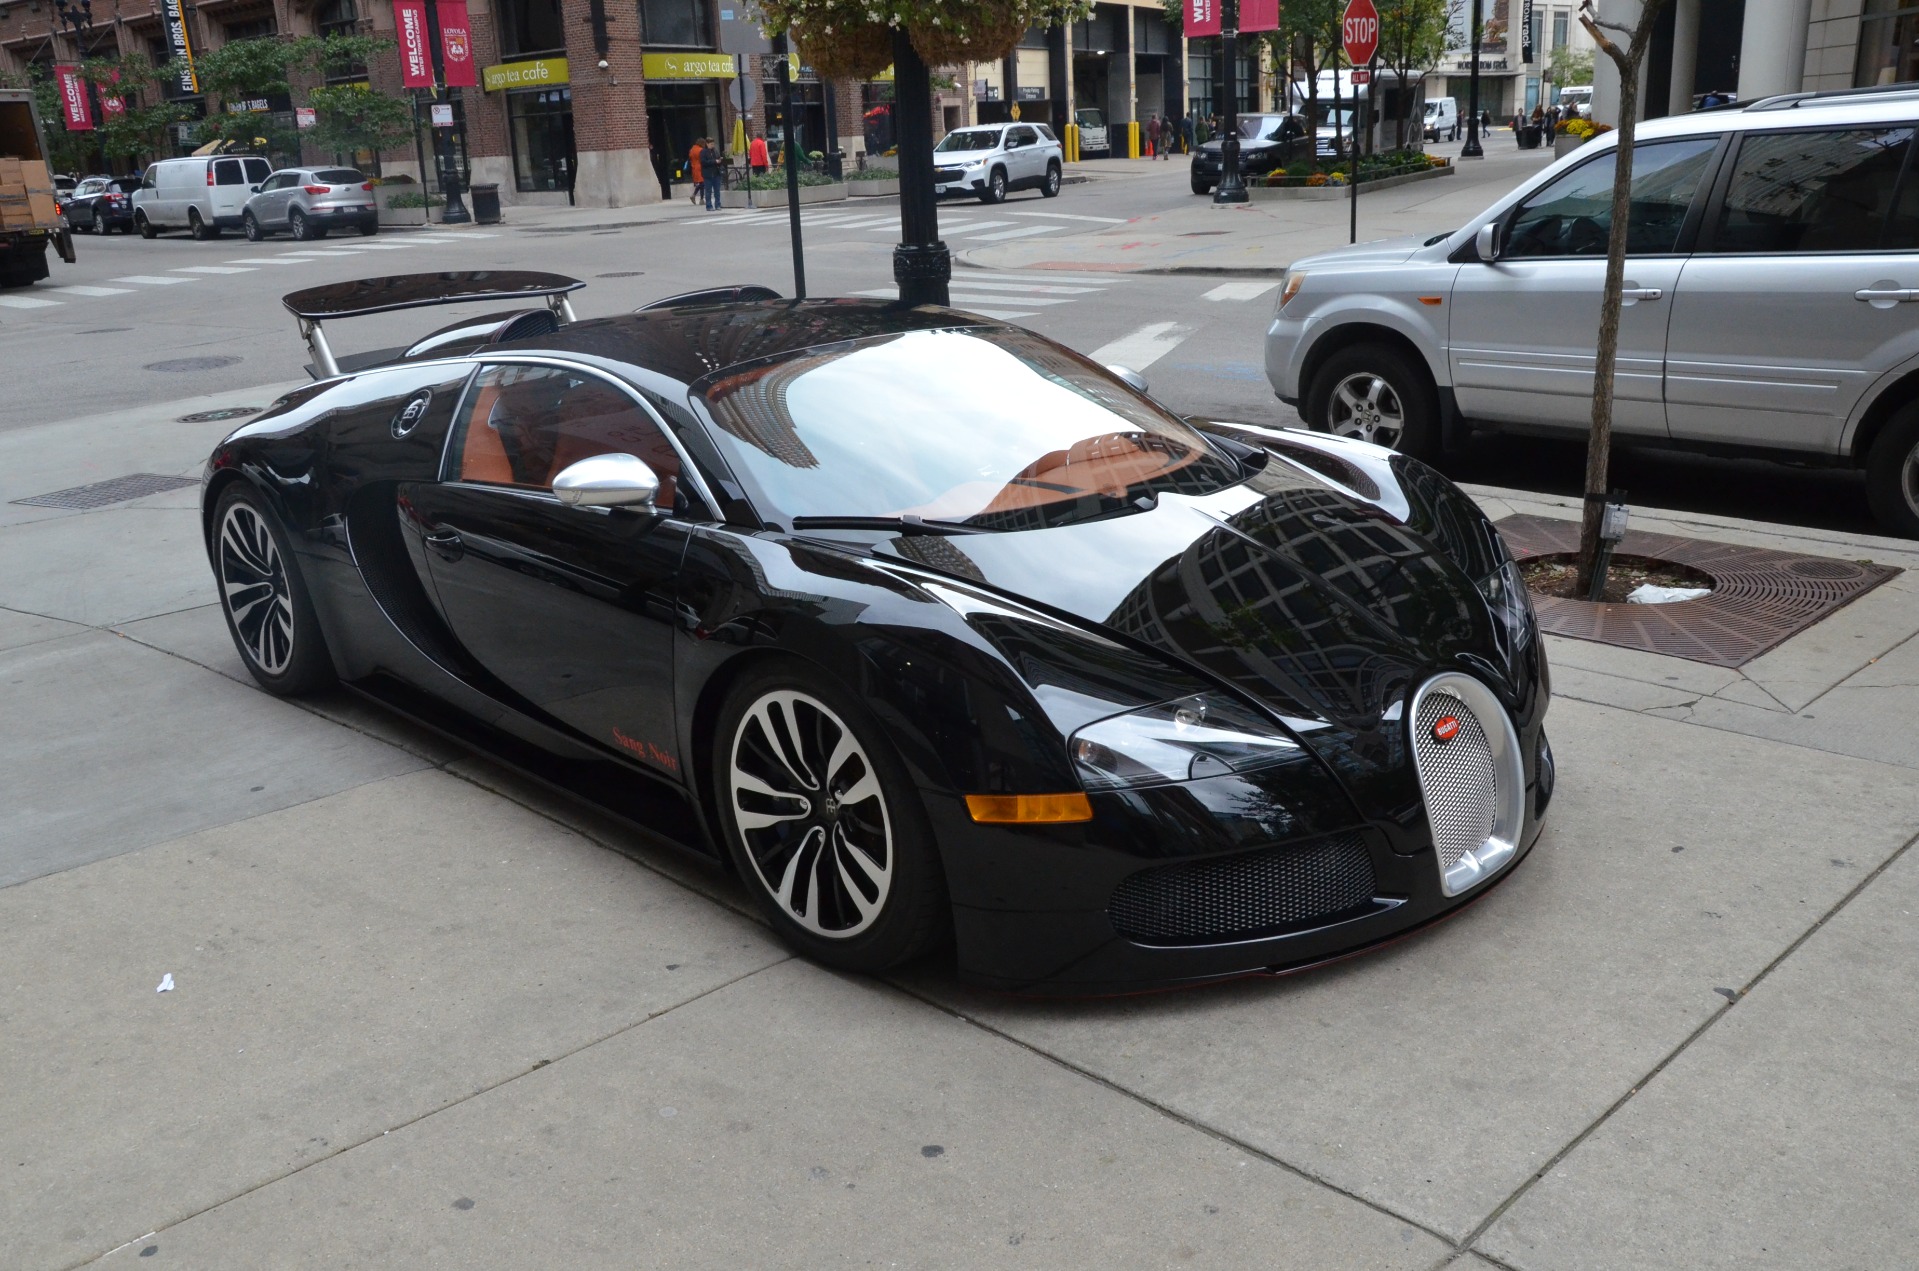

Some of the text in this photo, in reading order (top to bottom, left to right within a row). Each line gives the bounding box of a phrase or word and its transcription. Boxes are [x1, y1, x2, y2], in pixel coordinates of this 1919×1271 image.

[171, 20, 185, 45] BROS.
[403, 9, 419, 76] WELCOME
[1345, 17, 1376, 43] STOP
[1523, 23, 1531, 47] rack
[492, 61, 548, 87] argo tea café
[684, 61, 706, 76] argo
[708, 60, 720, 72] tea
[1360, 73, 1368, 82] WAY
[63, 73, 80, 122] WELCOME
[1437, 721, 1457, 736] BUGATTI
